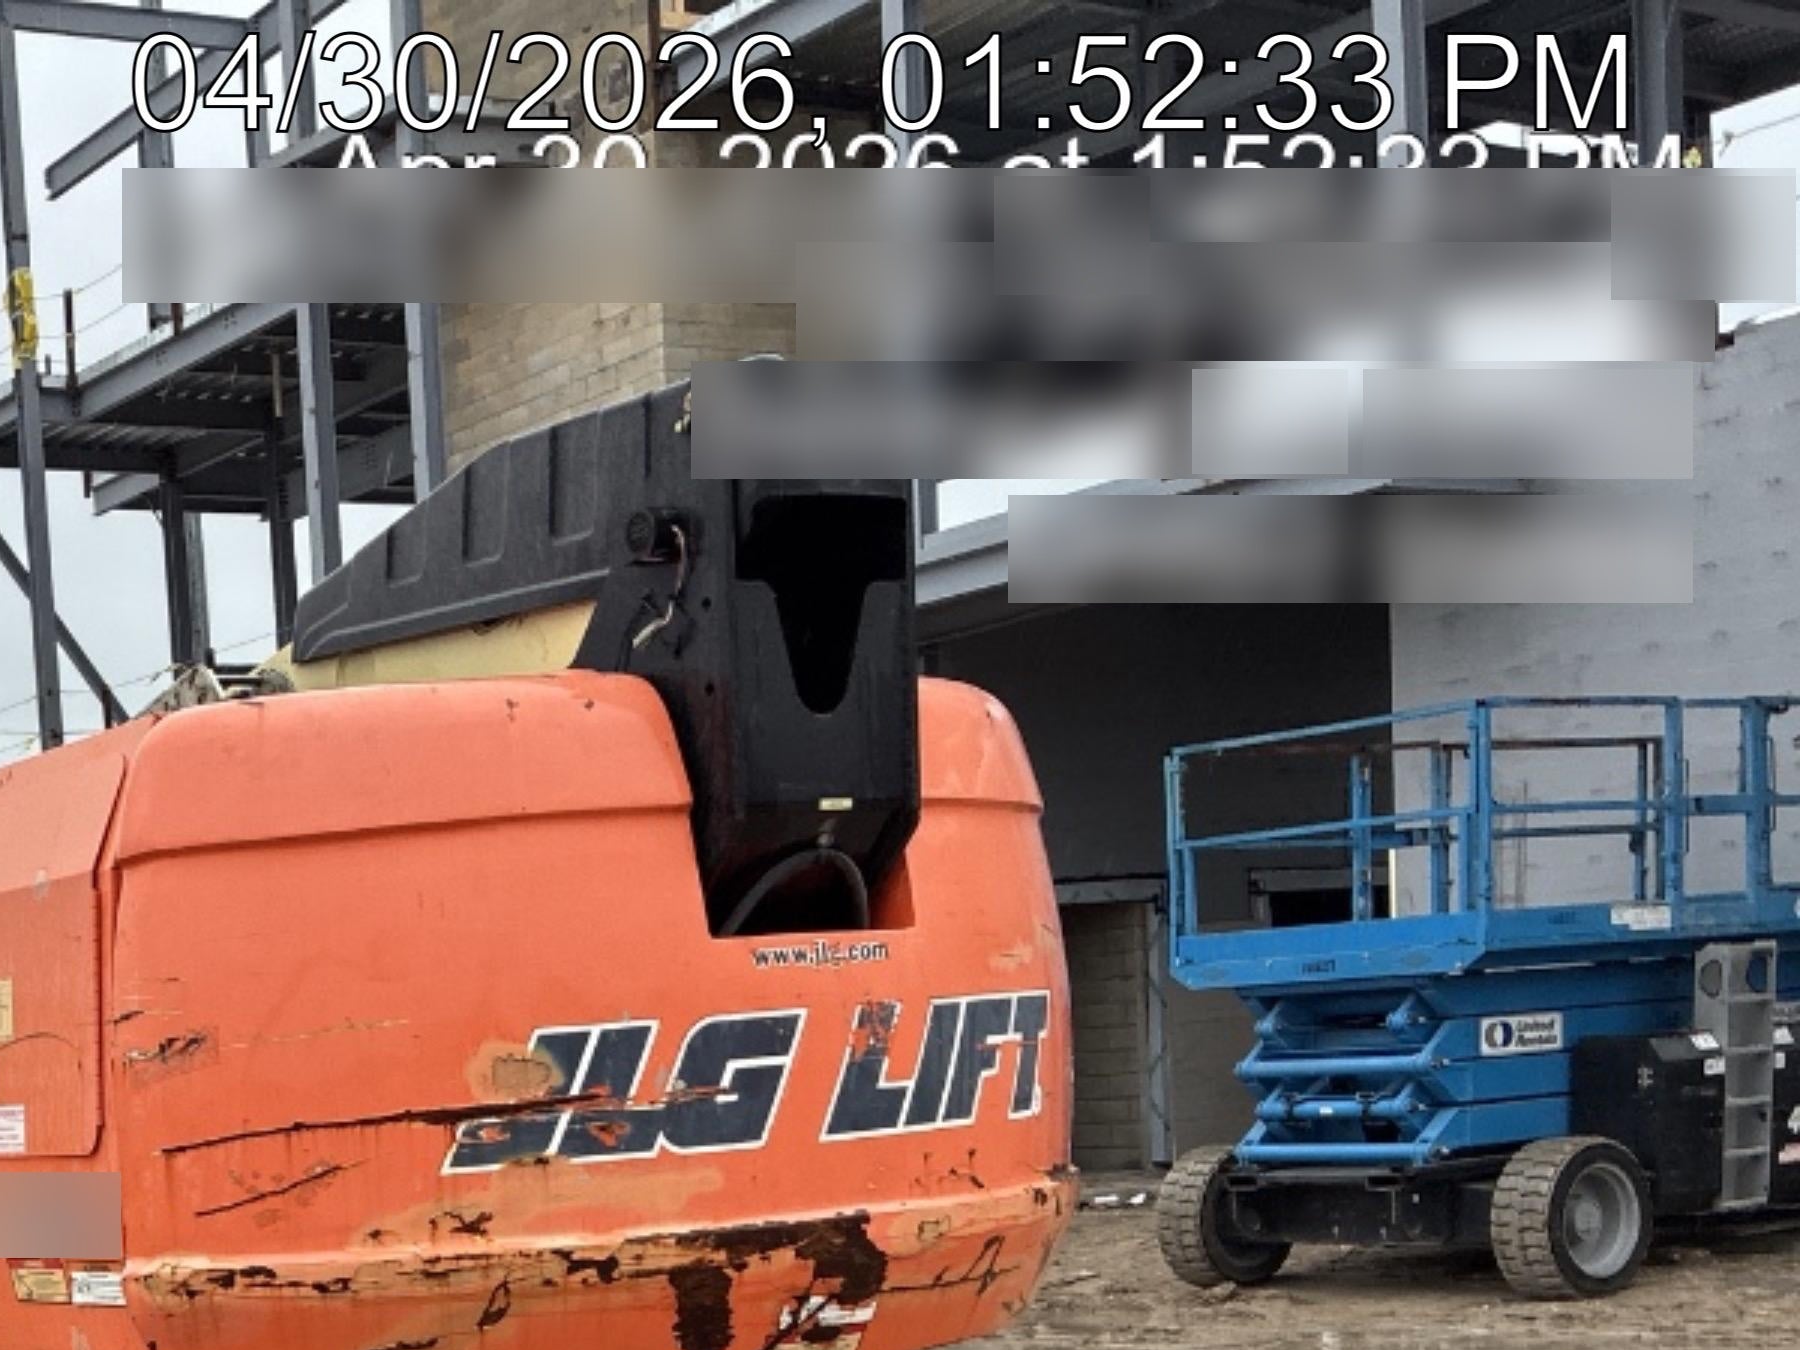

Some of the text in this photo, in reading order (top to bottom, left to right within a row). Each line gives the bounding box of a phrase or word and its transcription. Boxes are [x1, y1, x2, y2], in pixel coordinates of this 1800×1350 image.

[752, 940, 889, 969] www.jlg.com
[441, 991, 1050, 1175] JLG LIFT
